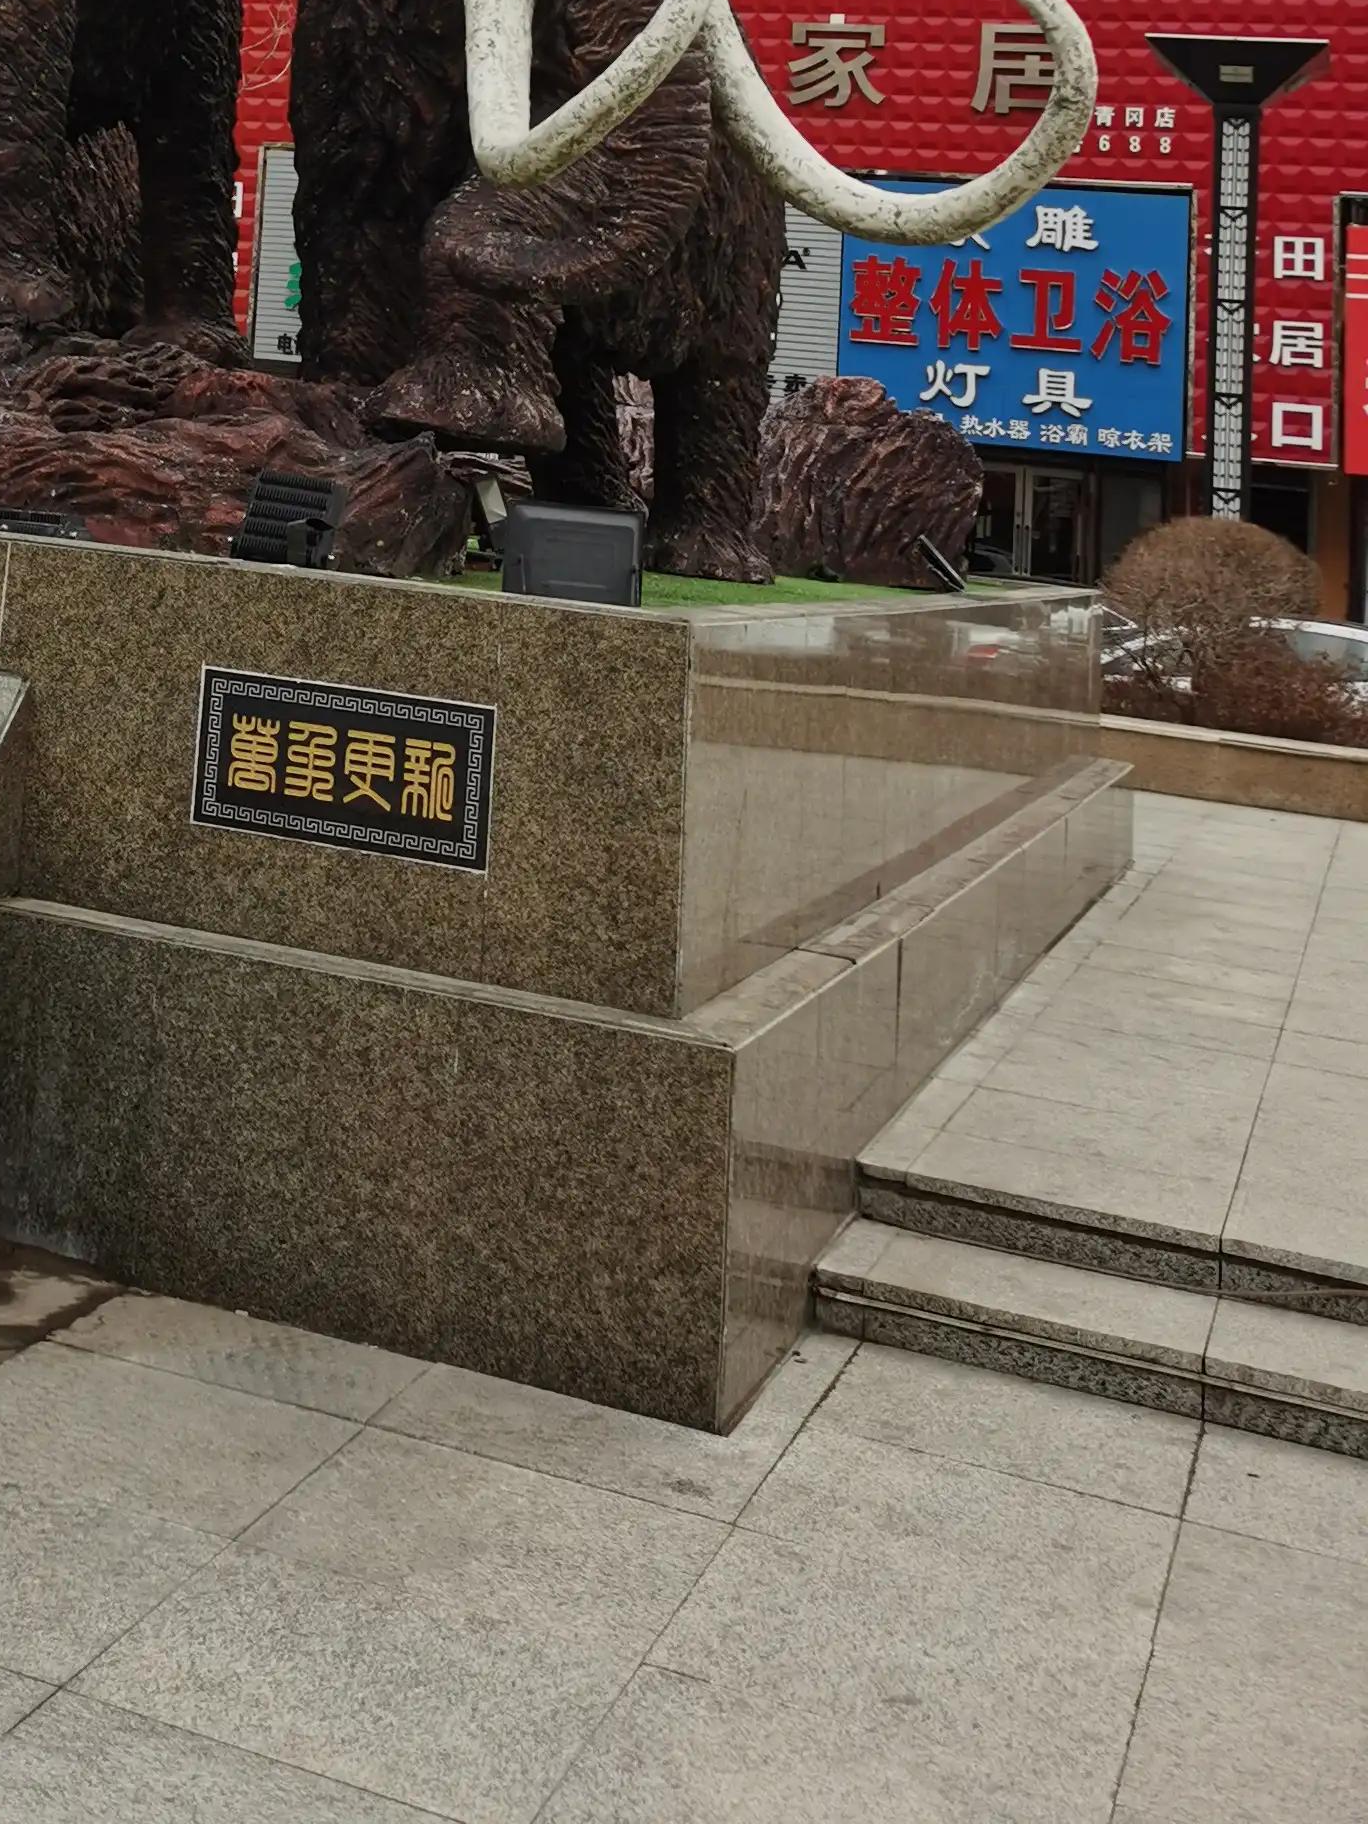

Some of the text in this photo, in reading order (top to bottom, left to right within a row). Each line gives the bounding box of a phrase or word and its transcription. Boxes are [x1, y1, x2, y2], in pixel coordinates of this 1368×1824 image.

[787, 13, 1058, 114] 家居
[1094, 105, 1177, 129] 青冈店
[848, 253, 1172, 366] 整体卫浴
[920, 359, 1093, 418] 灯具
[959, 414, 1032, 441] 热水器
[1040, 423, 1088, 447] 浴霸
